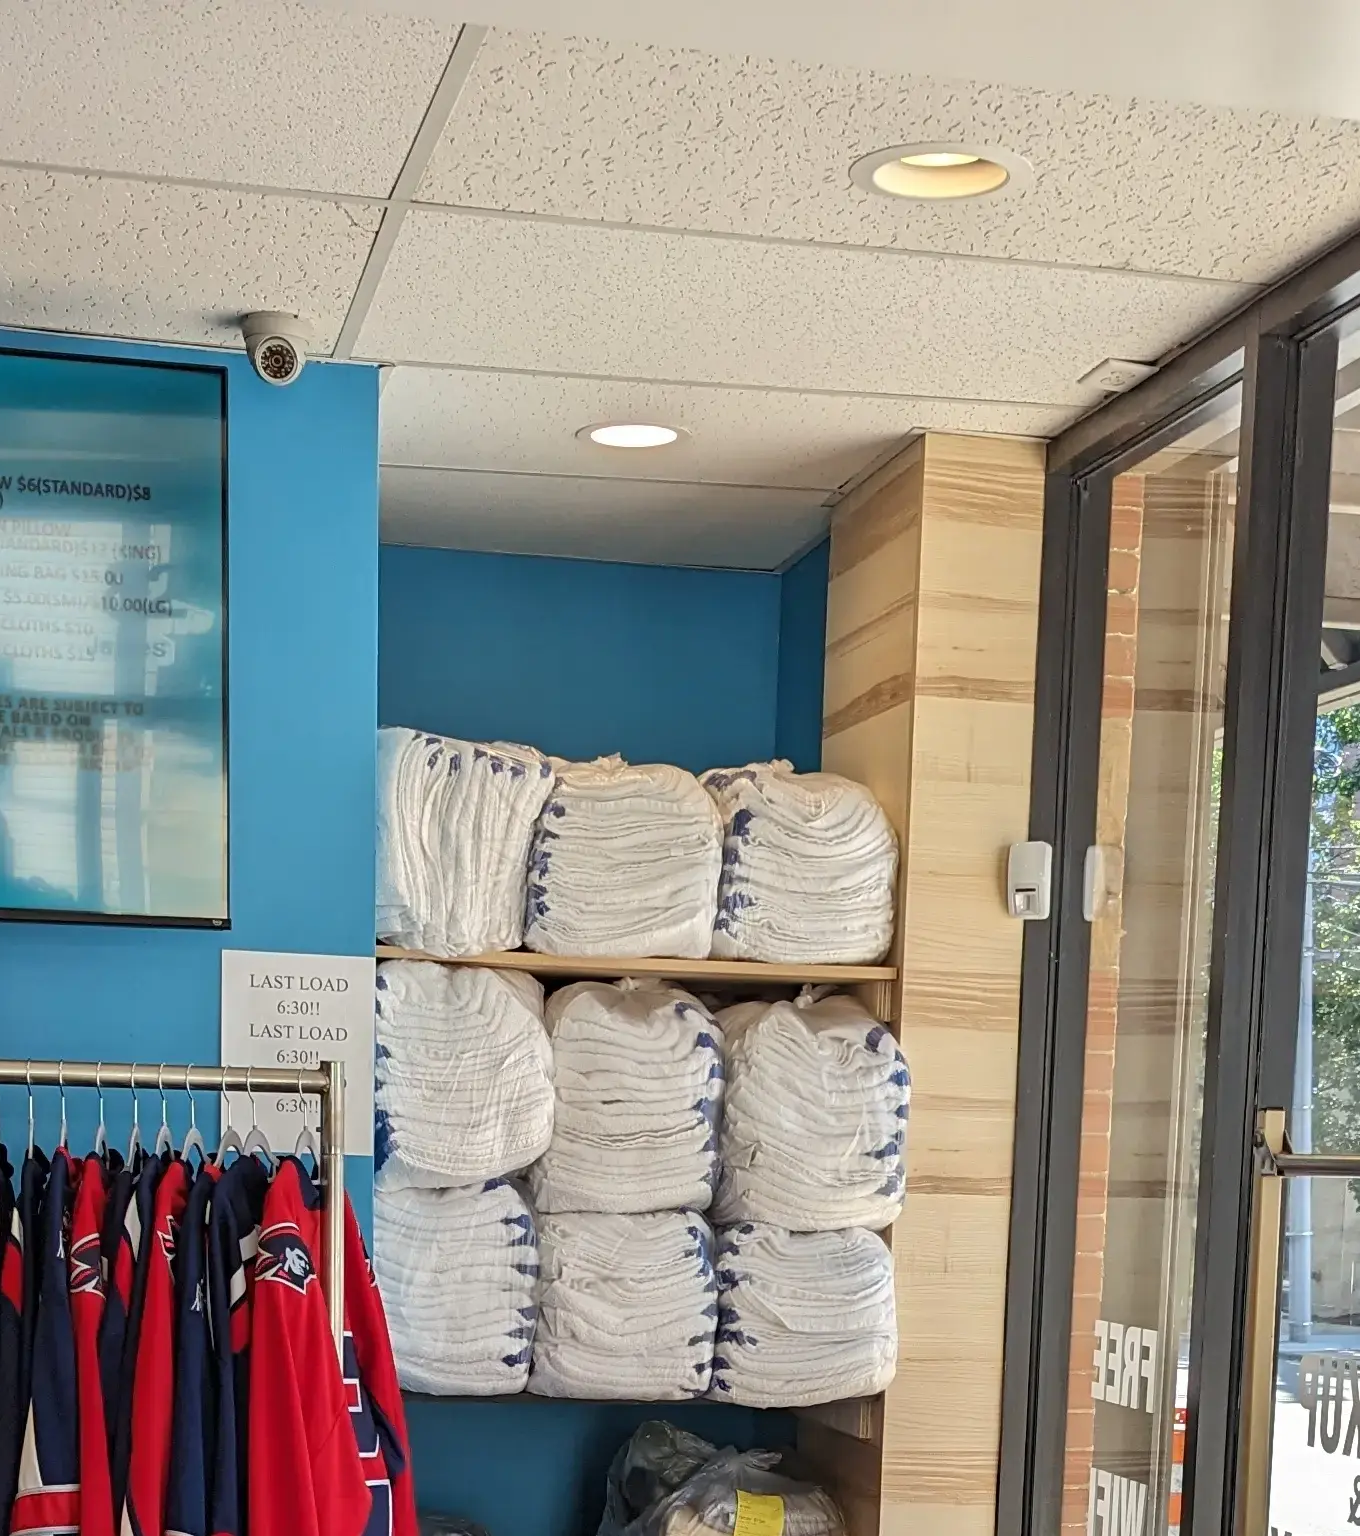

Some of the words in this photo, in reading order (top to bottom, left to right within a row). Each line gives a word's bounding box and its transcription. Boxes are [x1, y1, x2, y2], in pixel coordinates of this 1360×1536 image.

[249, 974, 294, 990] LAST
[299, 977, 349, 993] LOAD
[277, 1000, 320, 1016] 6:30!!
[249, 1023, 294, 1039] LAST
[298, 1026, 348, 1042] LOAD
[276, 1050, 320, 1065] 6:30!!
